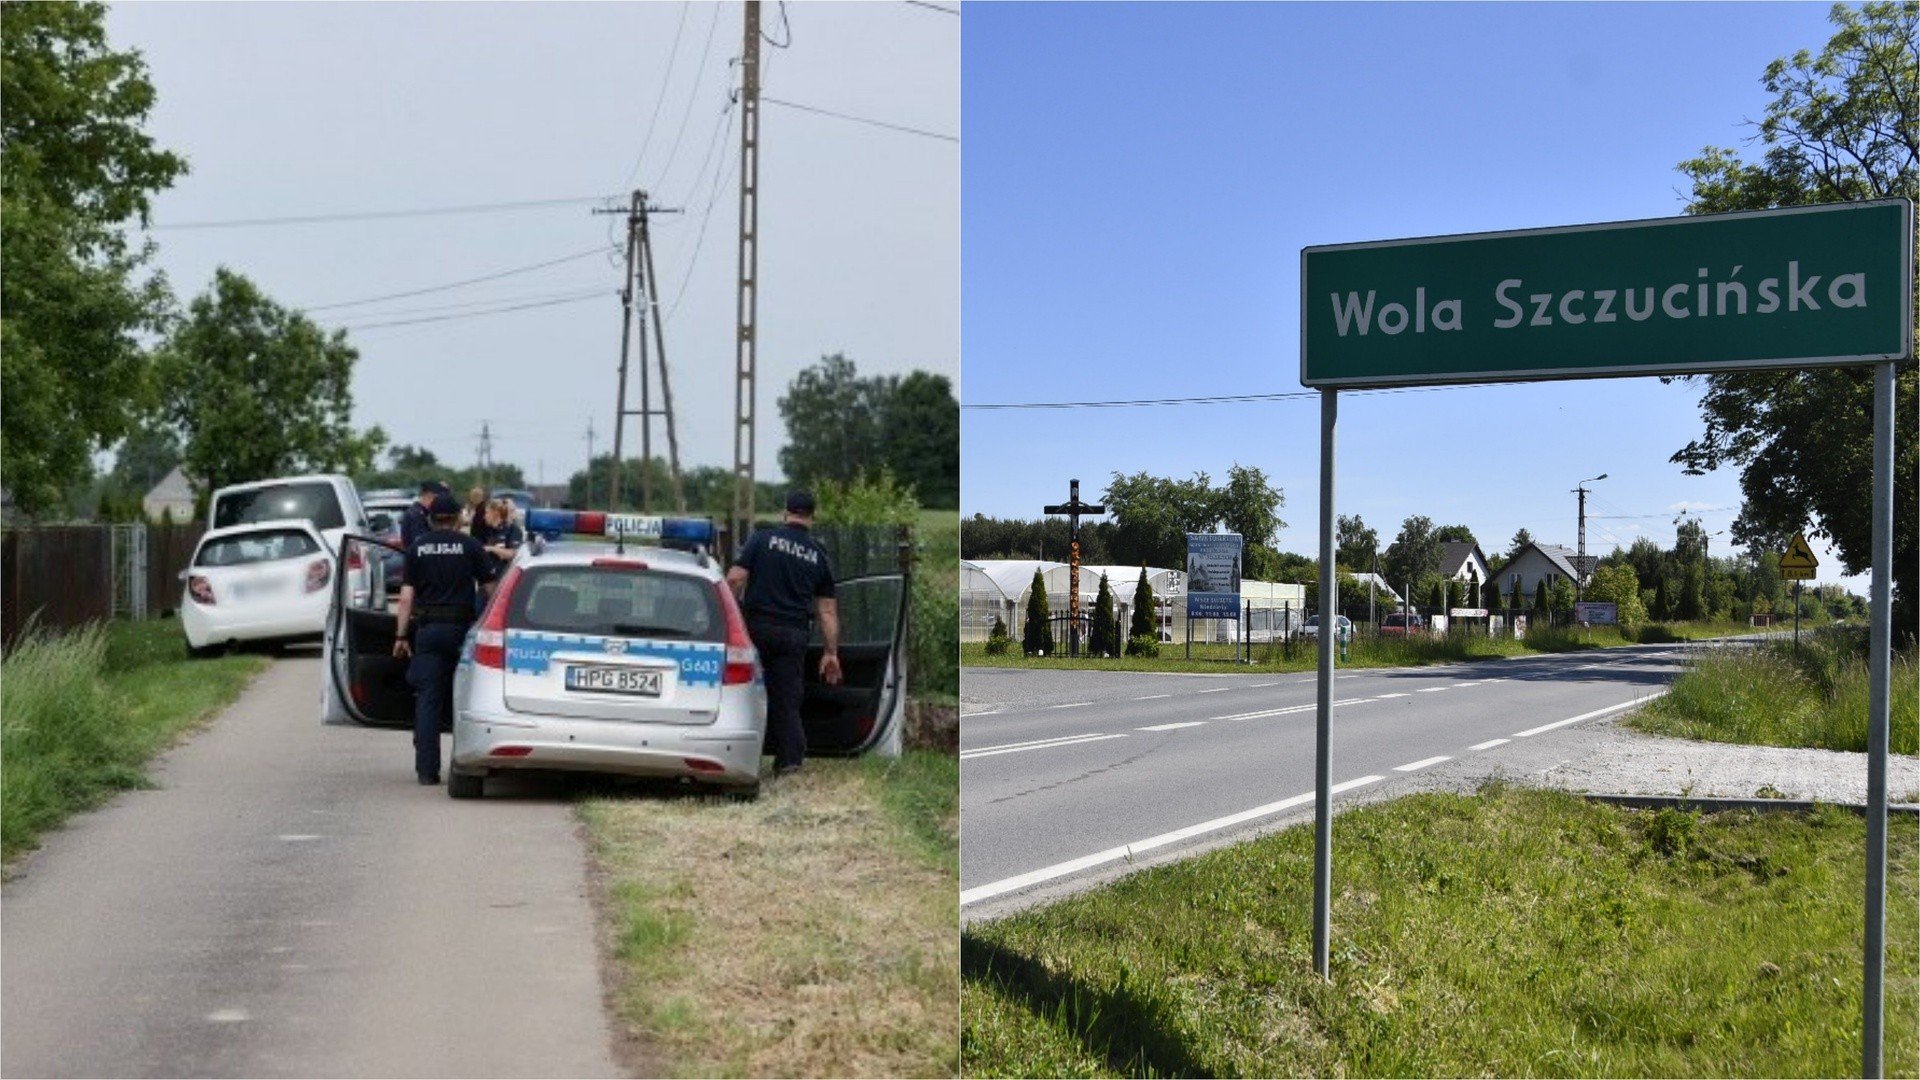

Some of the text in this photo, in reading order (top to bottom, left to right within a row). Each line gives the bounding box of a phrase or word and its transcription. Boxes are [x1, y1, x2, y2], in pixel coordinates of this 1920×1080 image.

[1330, 261, 1867, 337] Wola Szczucińska
[606, 517, 661, 535] POLICJA
[417, 543, 464, 557] POLICJA
[767, 535, 818, 565] POLICJA
[577, 669, 659, 691] HPG 8524
